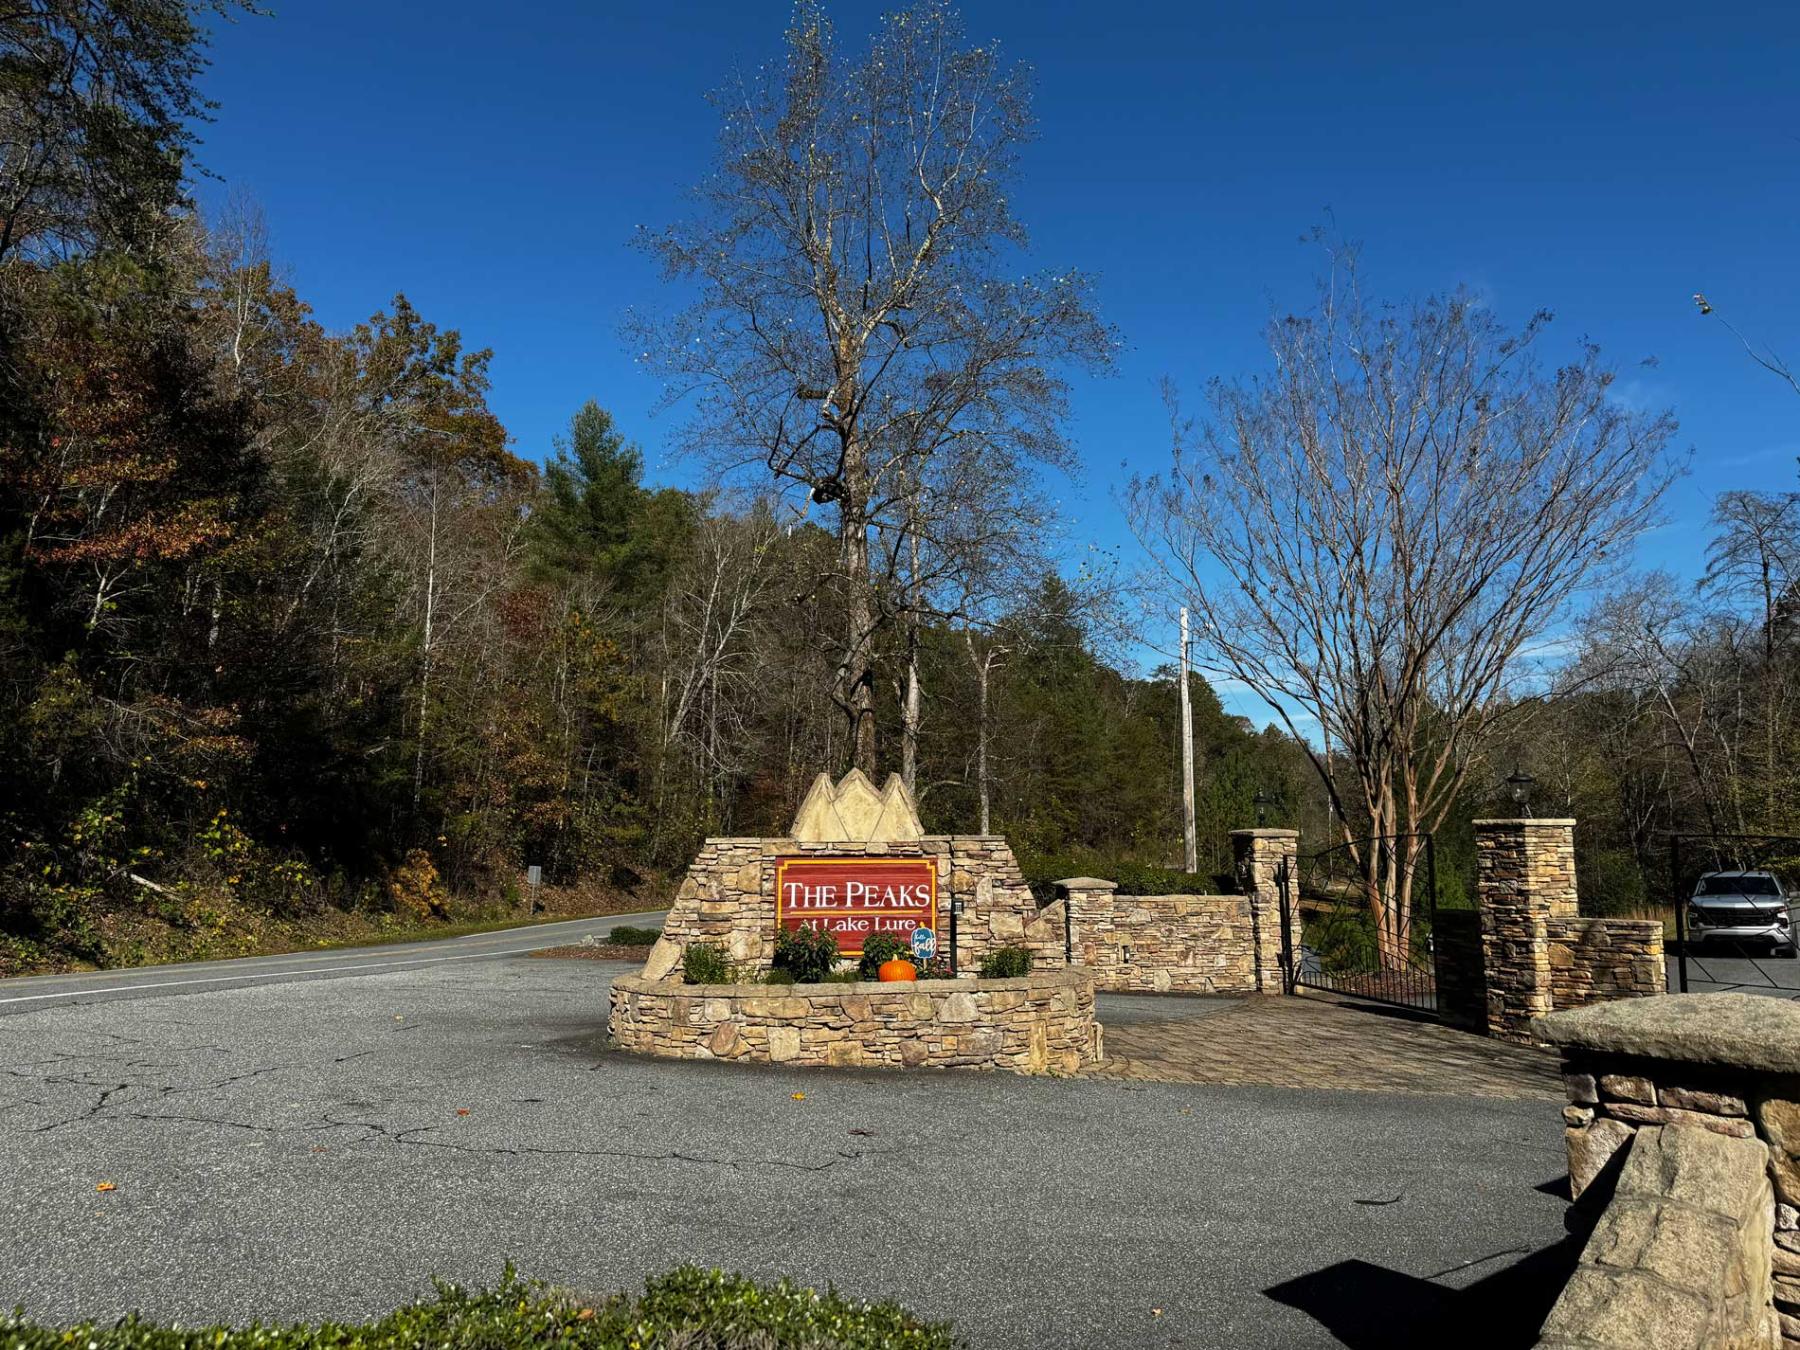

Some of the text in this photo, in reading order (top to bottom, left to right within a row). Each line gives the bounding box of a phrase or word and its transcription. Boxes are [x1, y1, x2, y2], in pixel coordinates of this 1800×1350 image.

[784, 881, 931, 908] THE PEAKS
[796, 917, 917, 932] At Lake Lure
